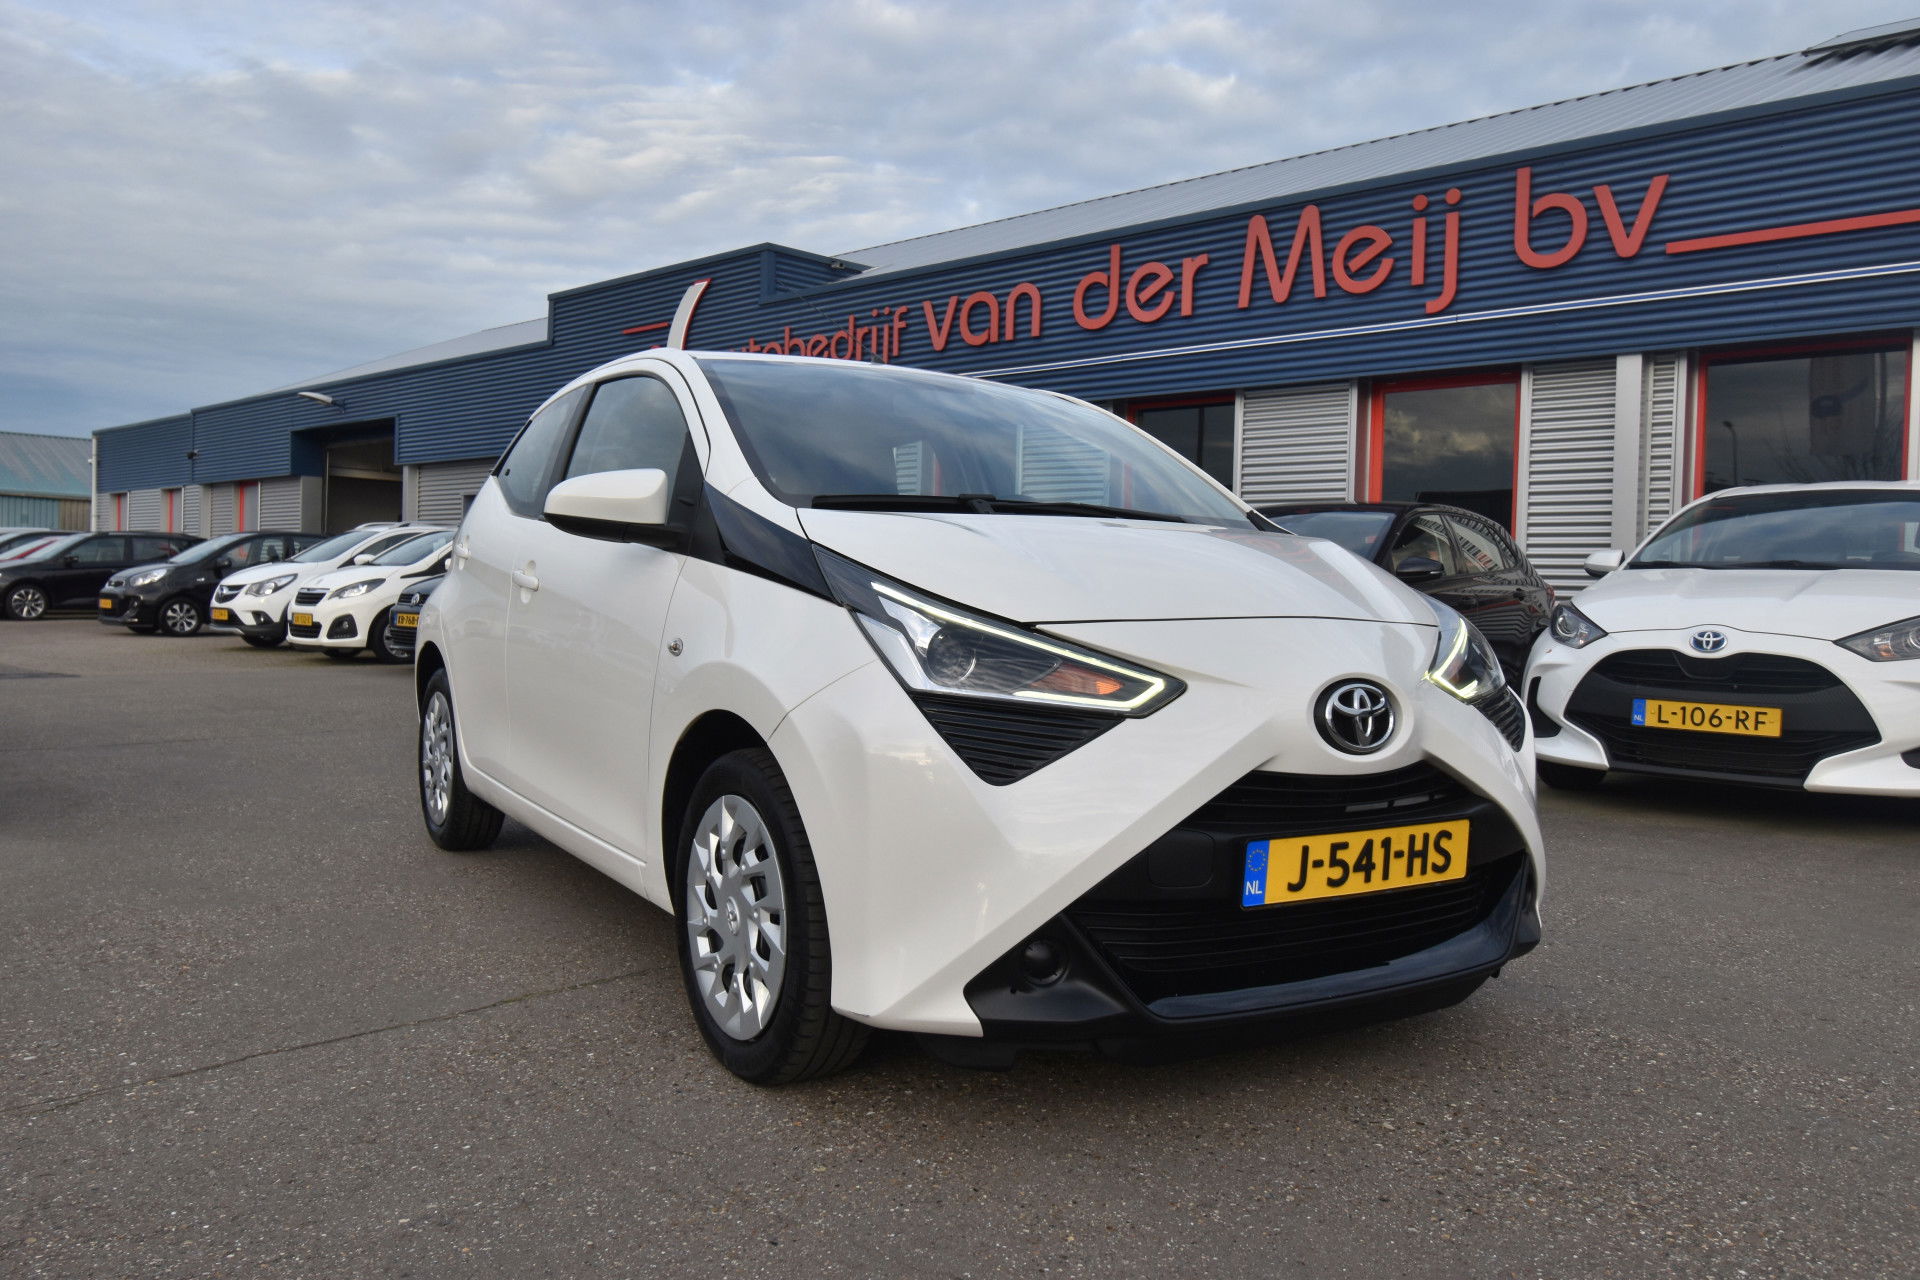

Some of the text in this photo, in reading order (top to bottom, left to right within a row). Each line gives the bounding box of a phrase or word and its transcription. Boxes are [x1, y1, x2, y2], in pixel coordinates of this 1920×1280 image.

[922, 282, 1042, 352] van
[1072, 244, 1209, 330] der
[1237, 187, 1462, 315] Meij
[1513, 166, 1670, 269] bv
[1656, 703, 1769, 732] L-106-RF
[1244, 829, 1454, 896] NL J-541-HS
